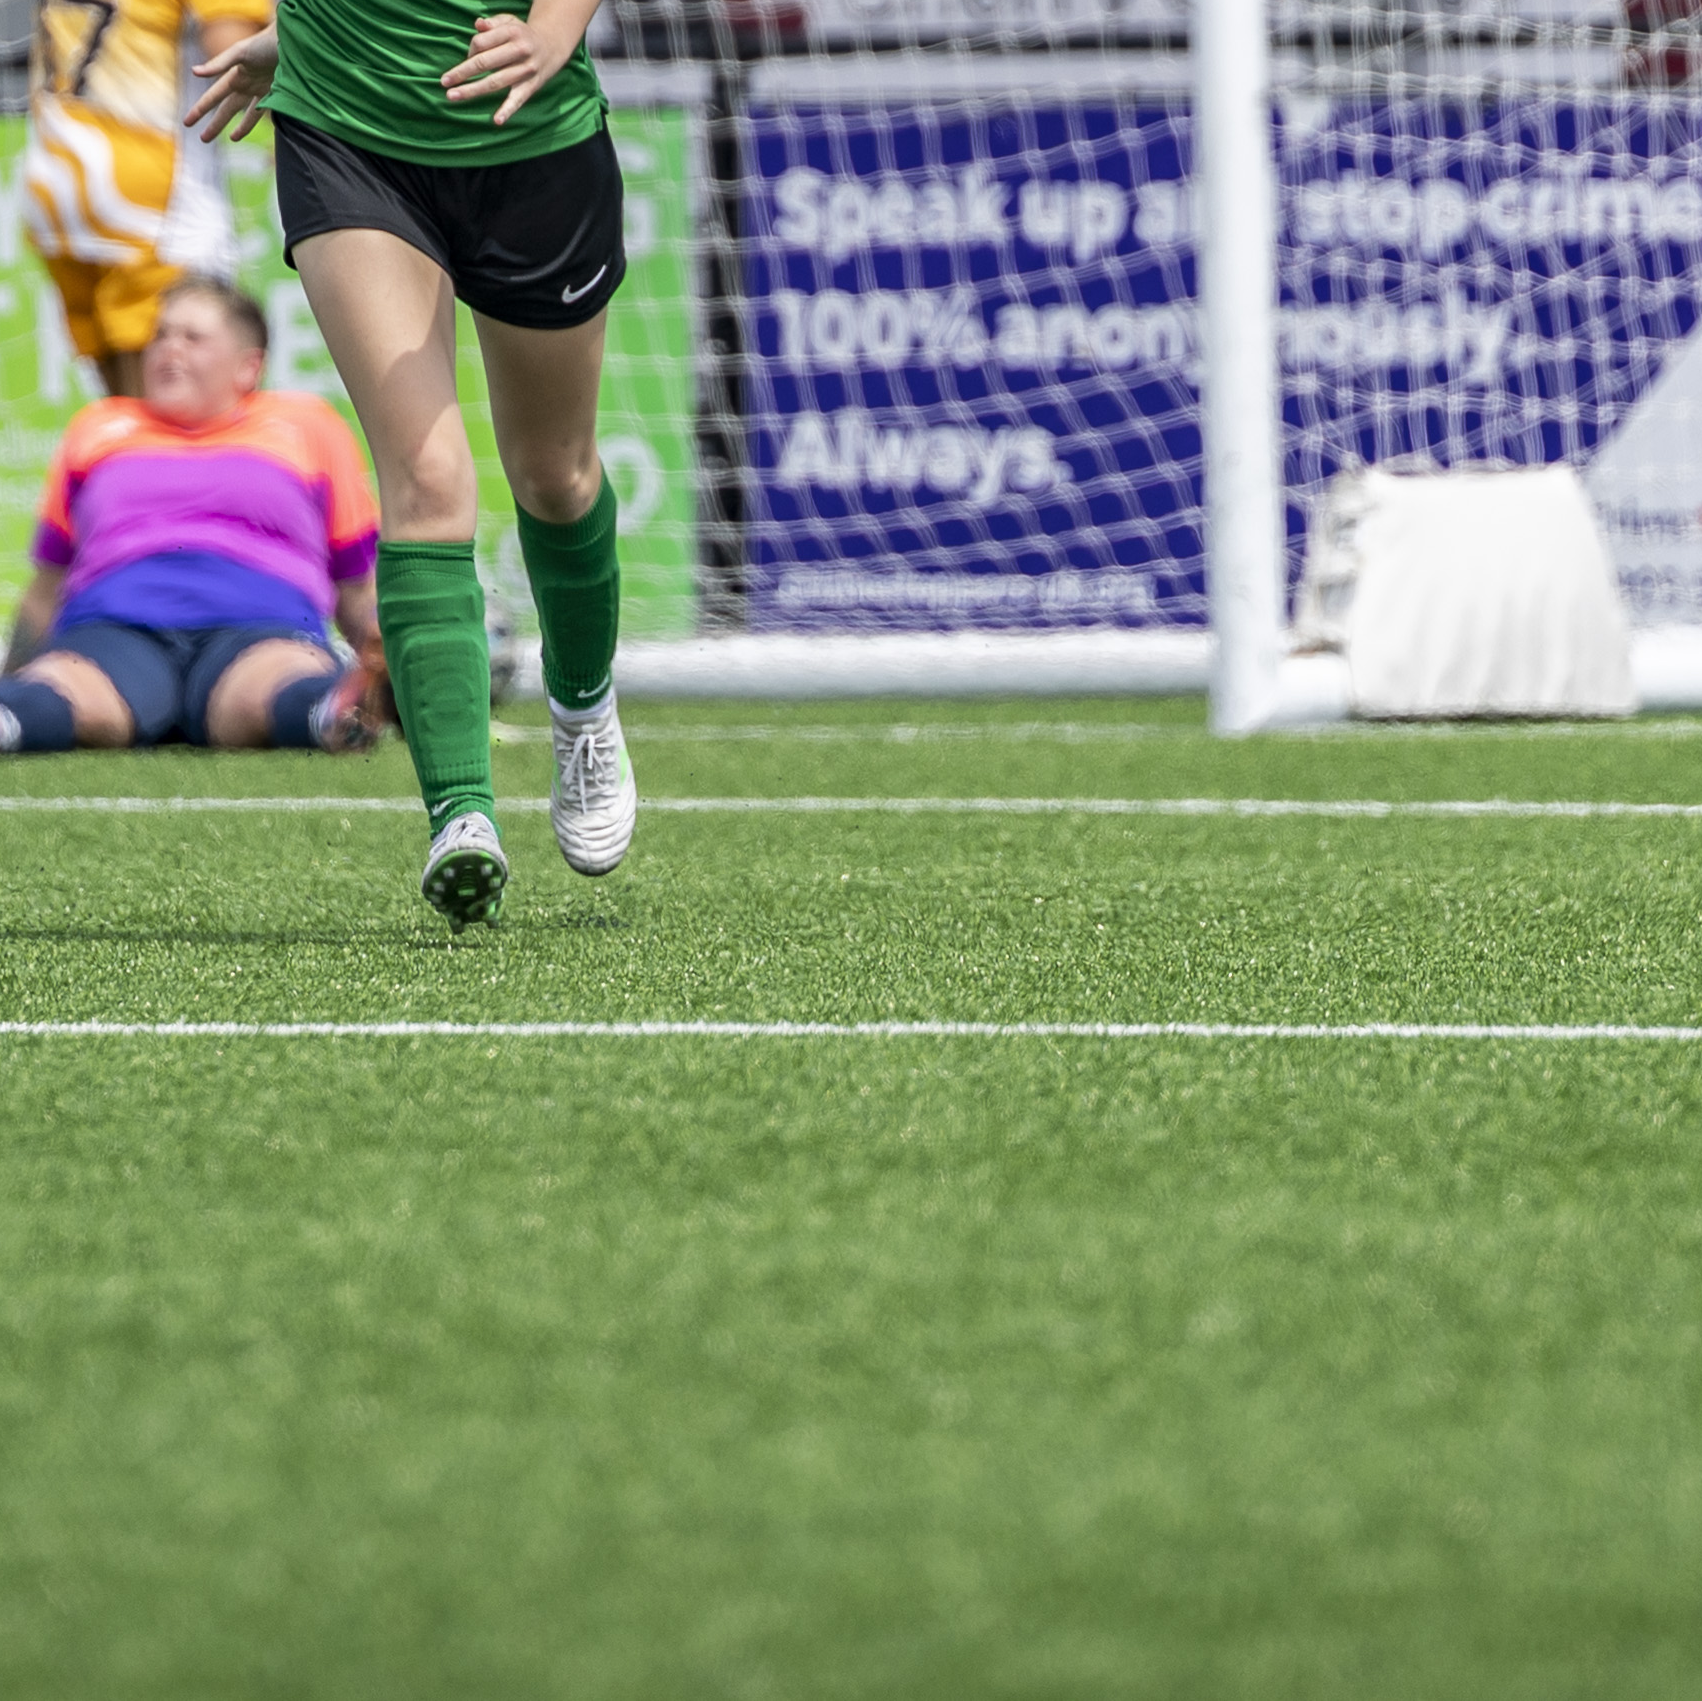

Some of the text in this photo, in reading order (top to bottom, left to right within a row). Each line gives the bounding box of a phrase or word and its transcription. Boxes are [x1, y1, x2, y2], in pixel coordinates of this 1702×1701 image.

[773, 166, 1007, 263] Speak
[1019, 178, 1129, 261] up
[1298, 171, 1474, 258] stop
[774, 288, 989, 371] 100%
